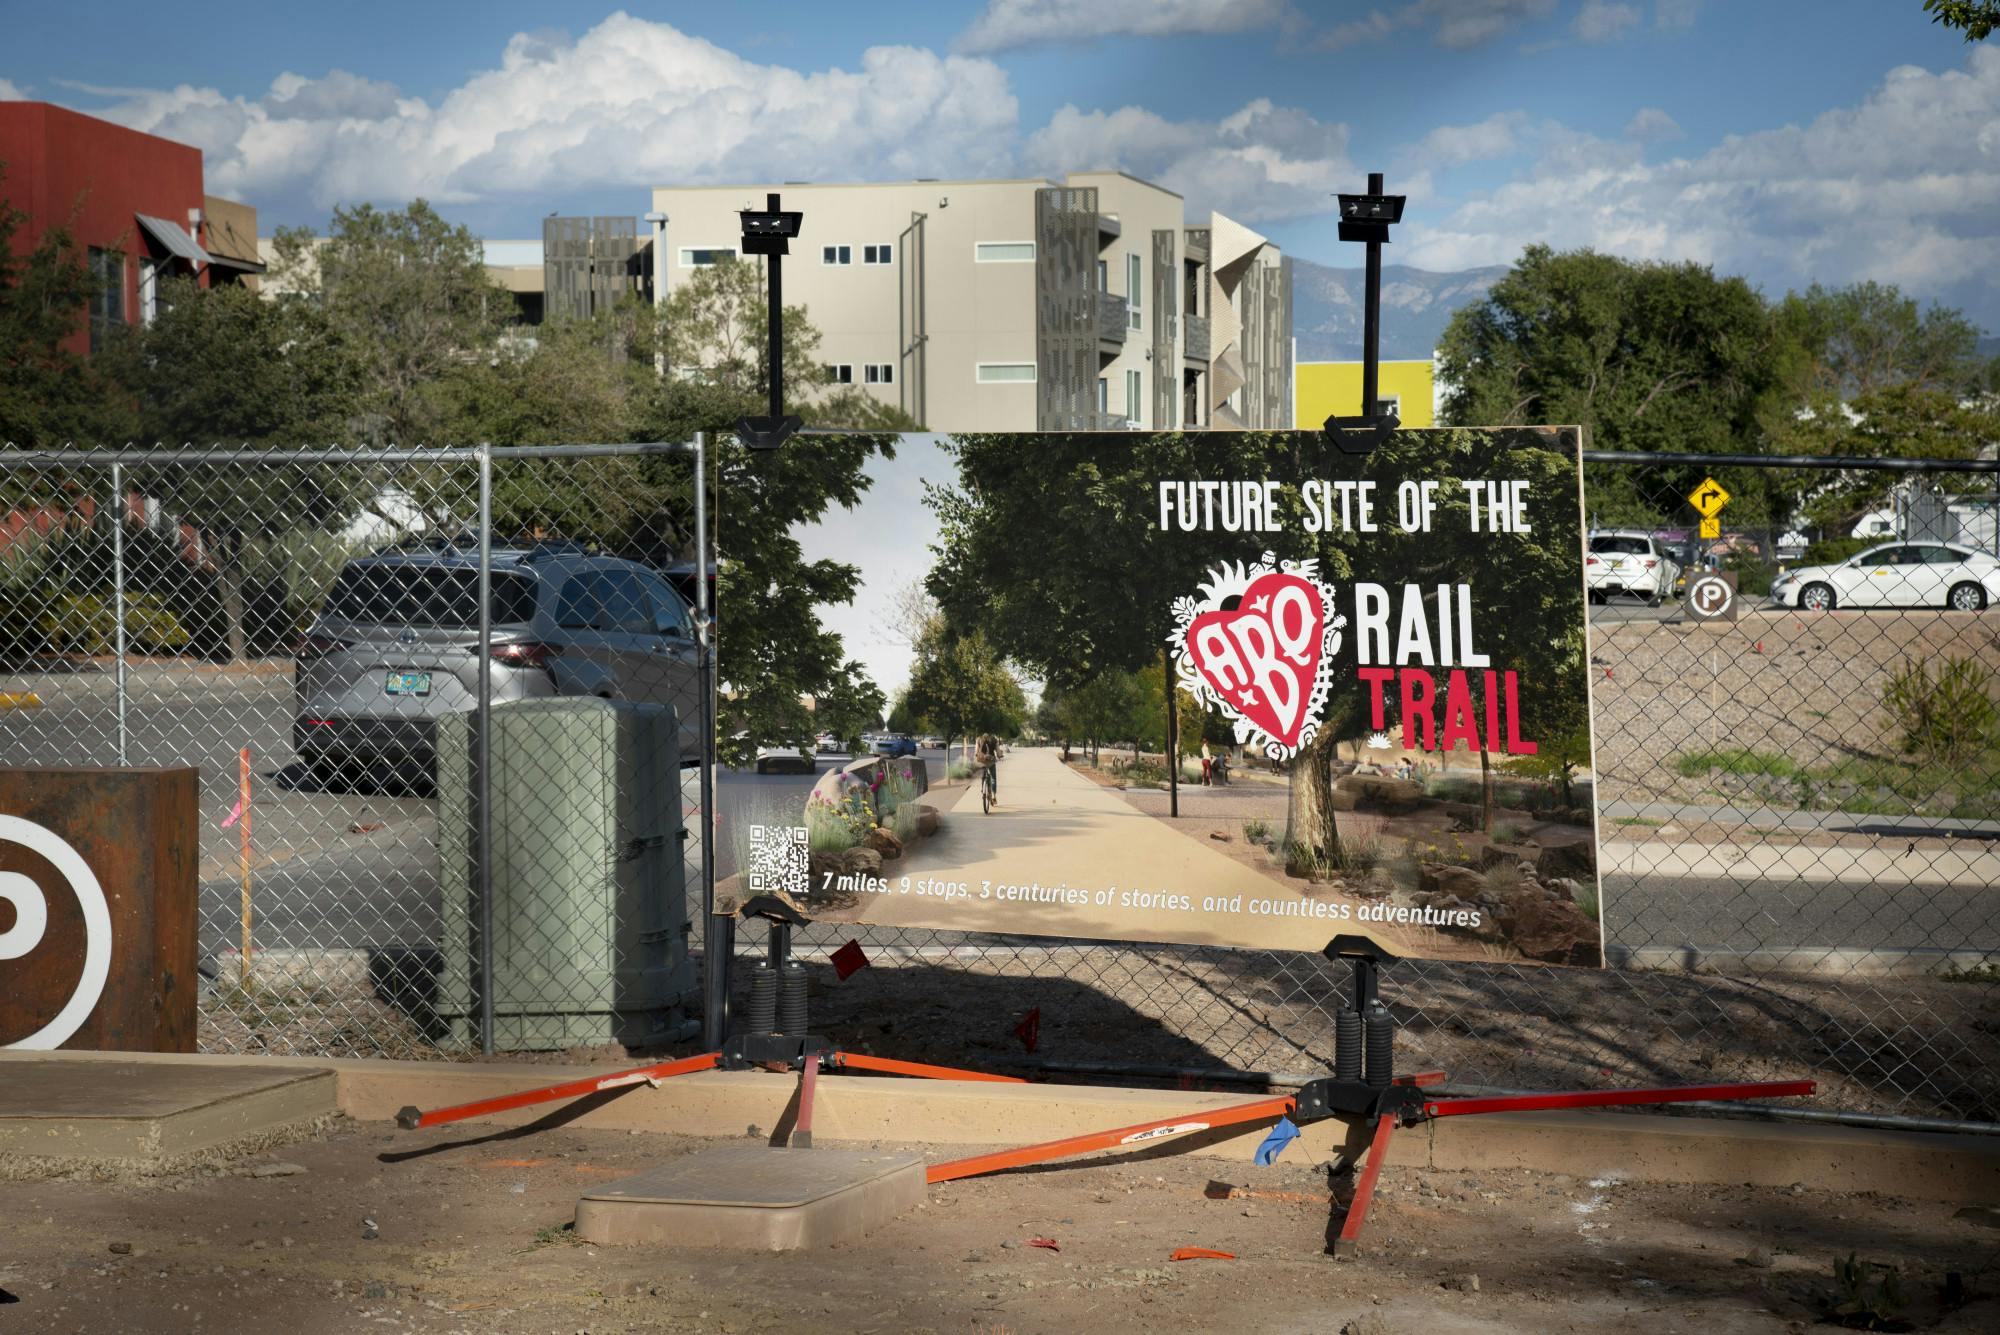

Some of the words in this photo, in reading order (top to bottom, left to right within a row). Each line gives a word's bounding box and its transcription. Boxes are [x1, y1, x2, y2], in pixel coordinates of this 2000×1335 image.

[1159, 480, 1282, 532] FUTURE
[1302, 480, 1378, 533] SITE
[1399, 480, 1439, 533] OF
[1462, 480, 1532, 533] THE
[1354, 582, 1491, 667] RAIL
[1702, 584, 1721, 608] P
[1195, 585, 1317, 736] ABQ
[1358, 667, 1538, 755] TRAIL
[822, 871, 834, 890] 7
[836, 872, 892, 895] miles,
[900, 876, 911, 893] 9
[916, 877, 972, 900] stops,
[979, 880, 990, 897] 3
[996, 882, 1089, 905] centuries
[1095, 886, 1116, 906] of
[1120, 889, 1195, 913] stories,
[1203, 894, 1242, 913] and
[1249, 898, 1351, 920] countless
[1358, 902, 1482, 928] adventures
